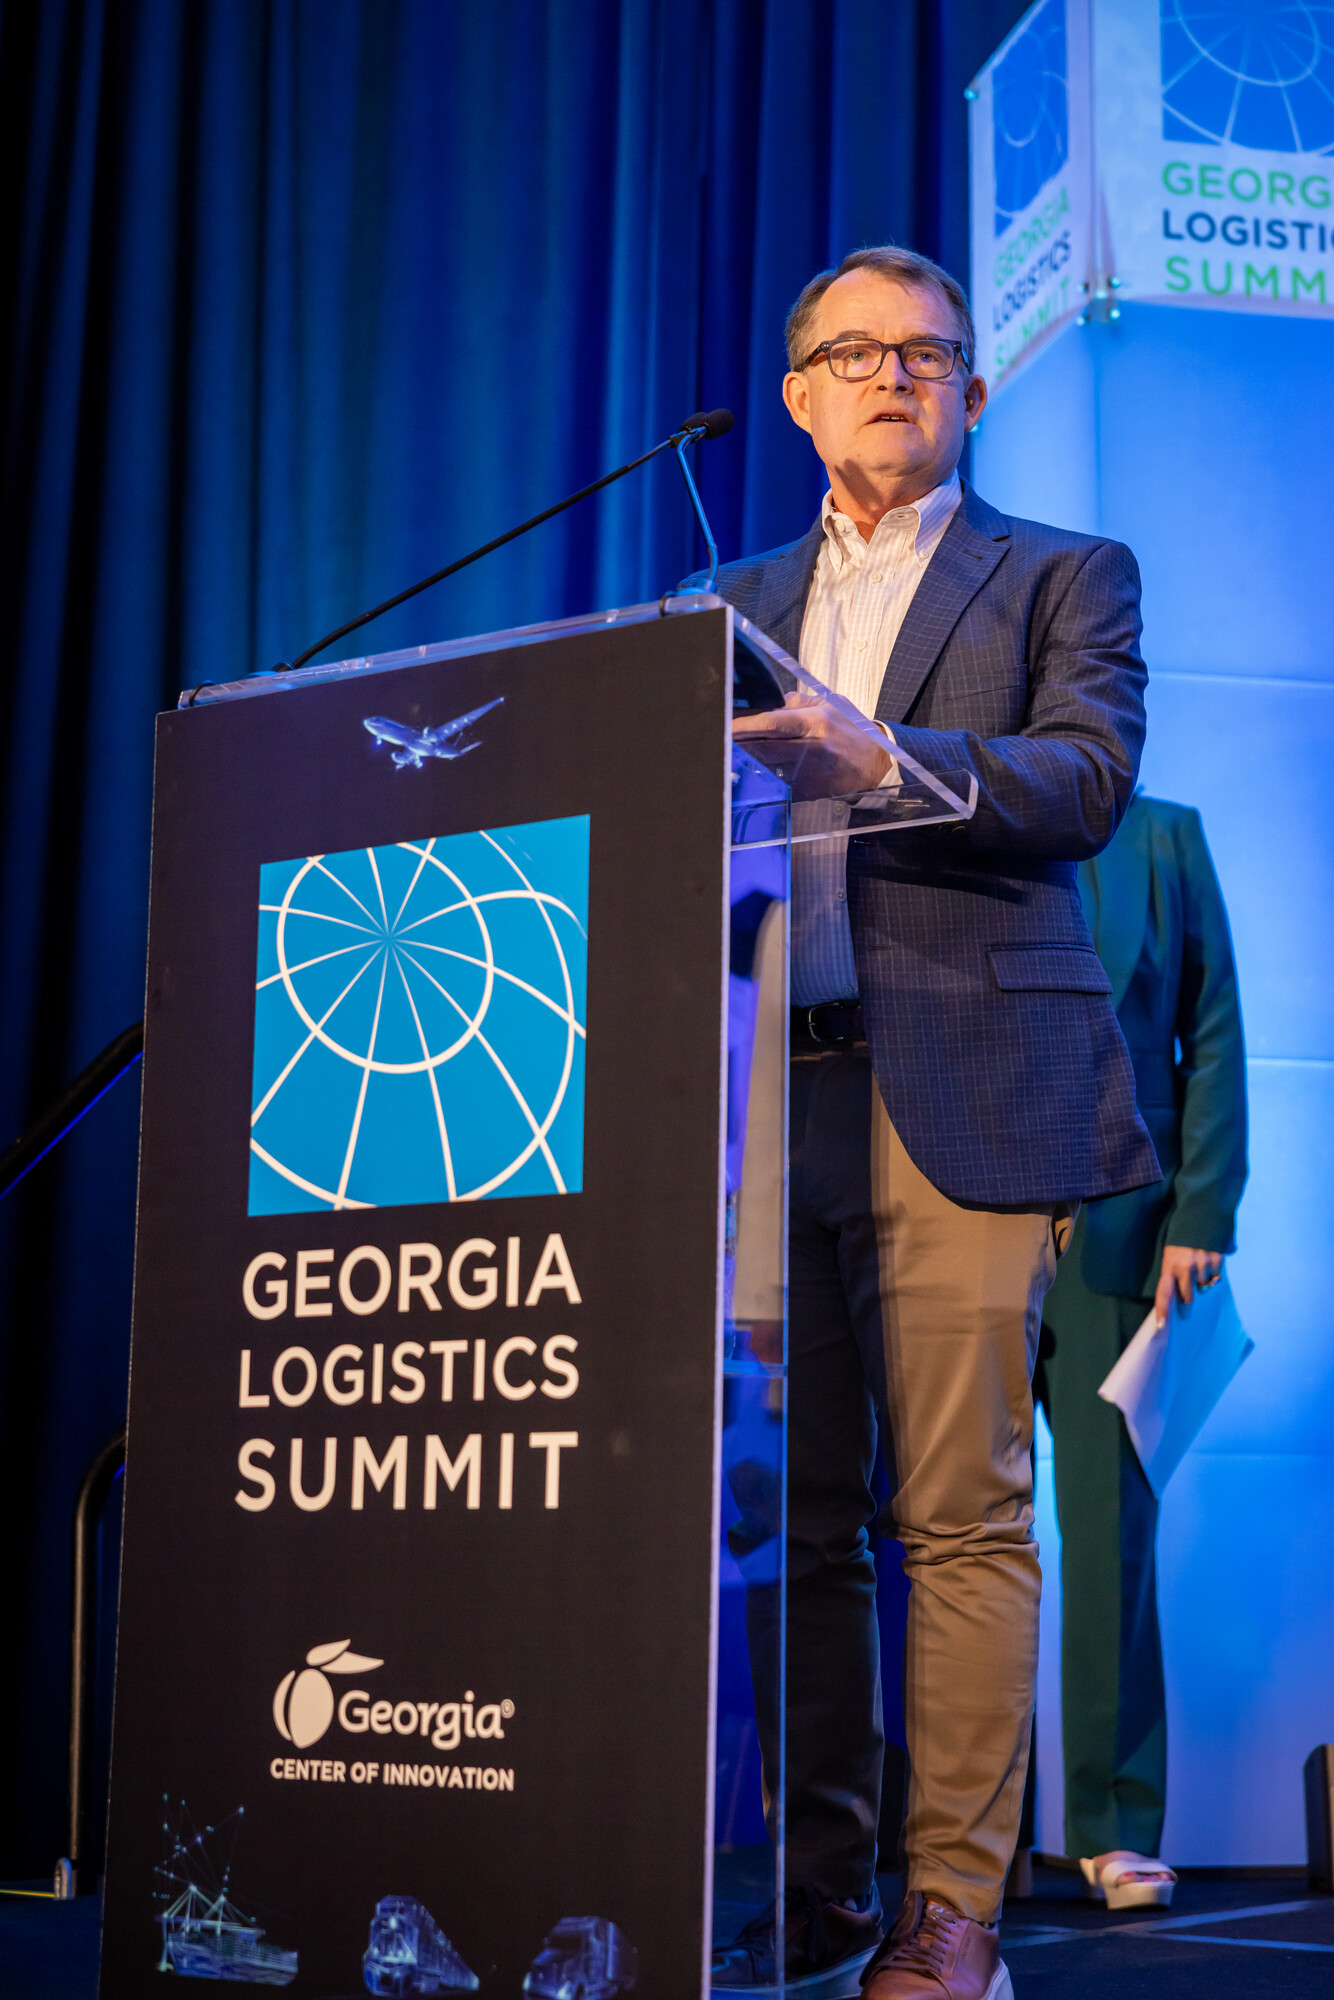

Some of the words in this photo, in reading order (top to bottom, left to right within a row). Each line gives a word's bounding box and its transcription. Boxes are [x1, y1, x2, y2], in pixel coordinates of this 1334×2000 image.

[1163, 209, 1334, 254] LOGISTI
[993, 229, 1072, 333] LOGISTICS
[1166, 256, 1327, 305] SUMM
[994, 275, 1070, 380] SUMMIT
[242, 1233, 582, 1321] GEORGIA
[239, 1334, 580, 1408] LOGISTICS
[235, 1431, 579, 1512] SUMMIT
[270, 1758, 346, 1782] CENTER
[350, 1761, 379, 1784] OF
[383, 1763, 515, 1791] INNOVATION
